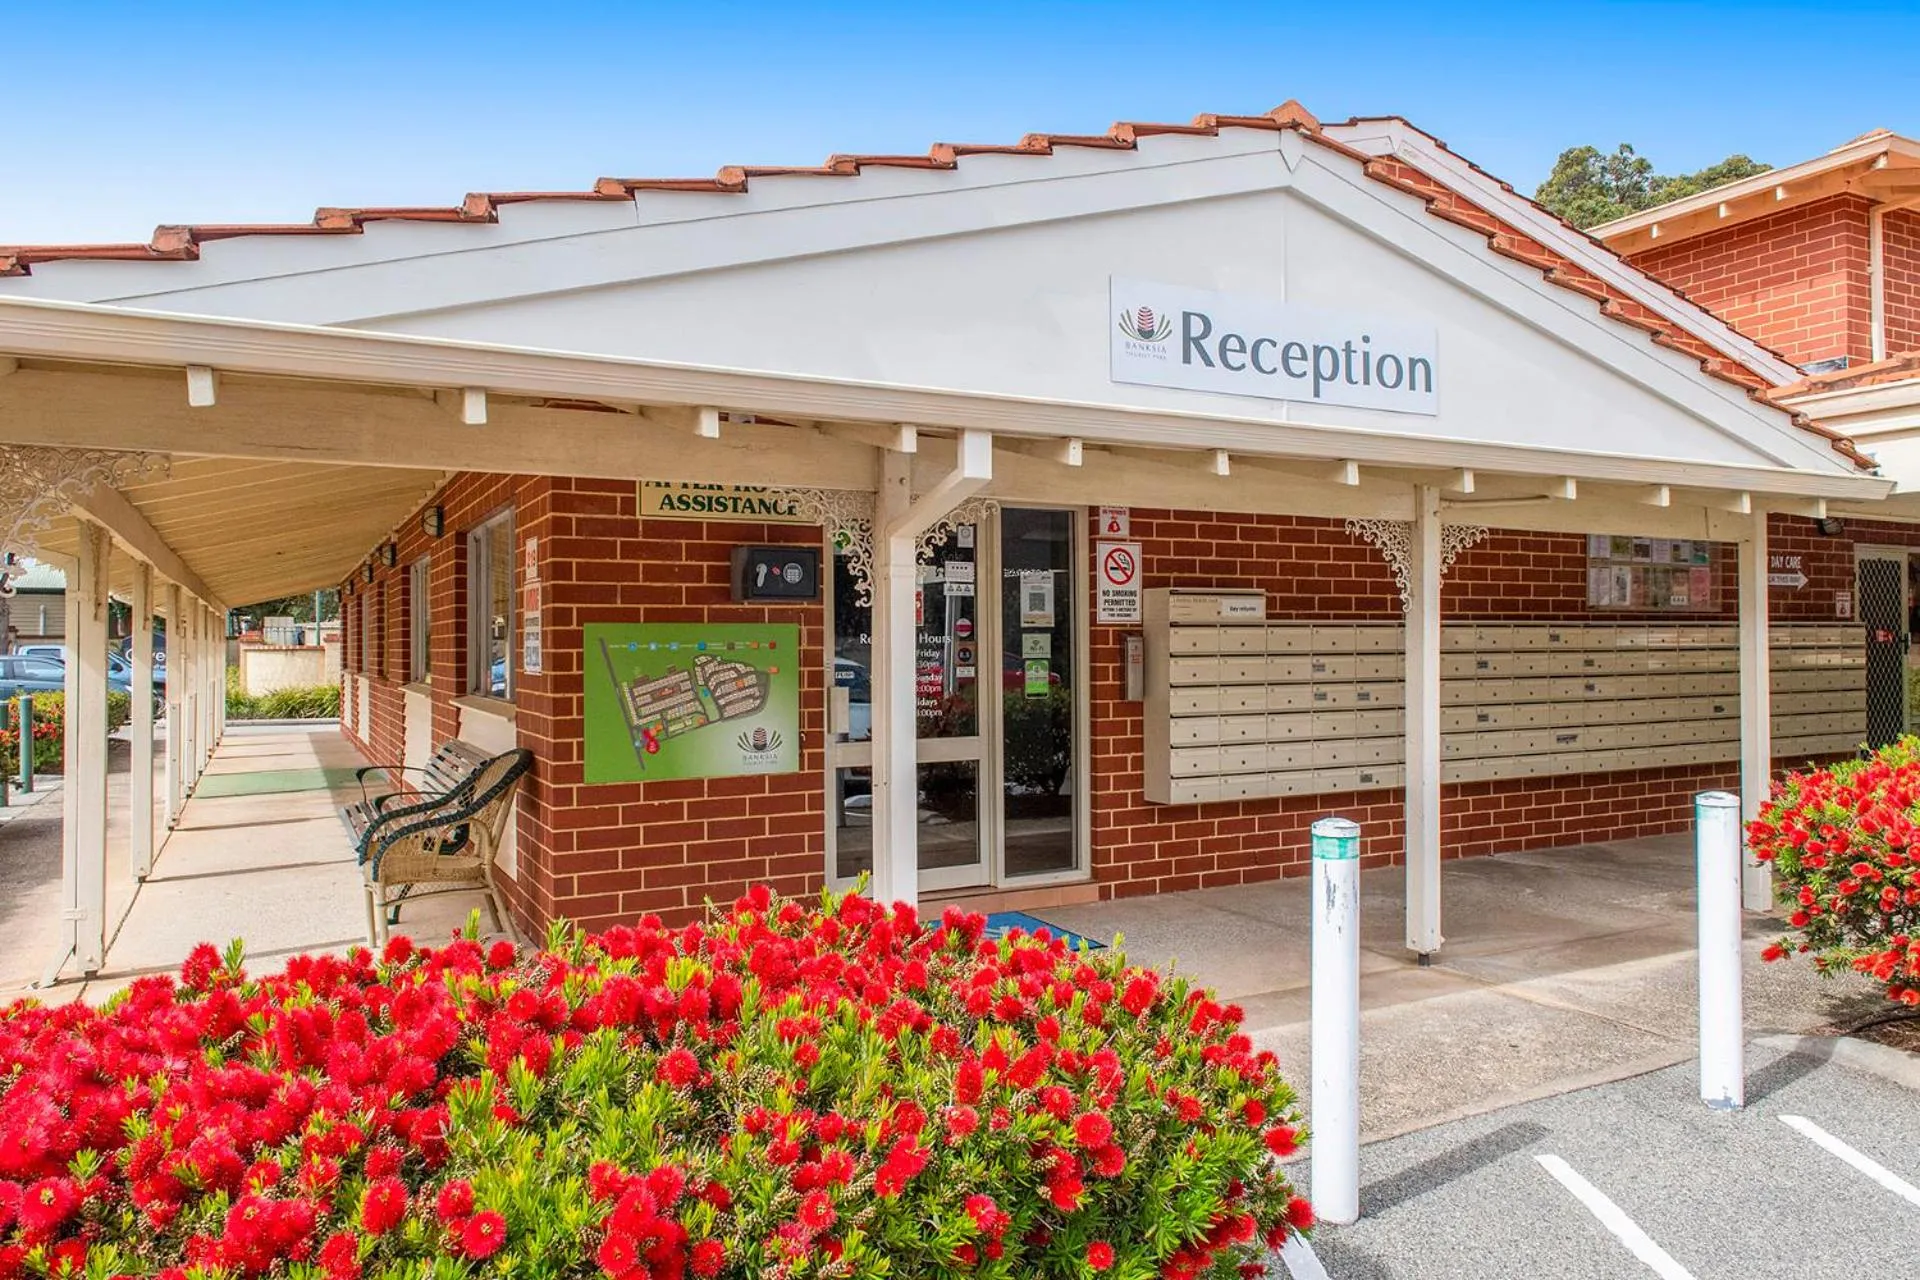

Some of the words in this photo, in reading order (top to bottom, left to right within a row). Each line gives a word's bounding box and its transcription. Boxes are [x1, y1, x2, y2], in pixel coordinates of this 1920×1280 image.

[1125, 341, 1167, 353] BANKSIA
[1182, 311, 1432, 397] Reception
[1771, 555, 1784, 568] DAY
[1785, 556, 1801, 568] CARE
[1102, 589, 1110, 597] NO
[1112, 590, 1137, 598] SMOKING
[919, 633, 952, 644] Hours
